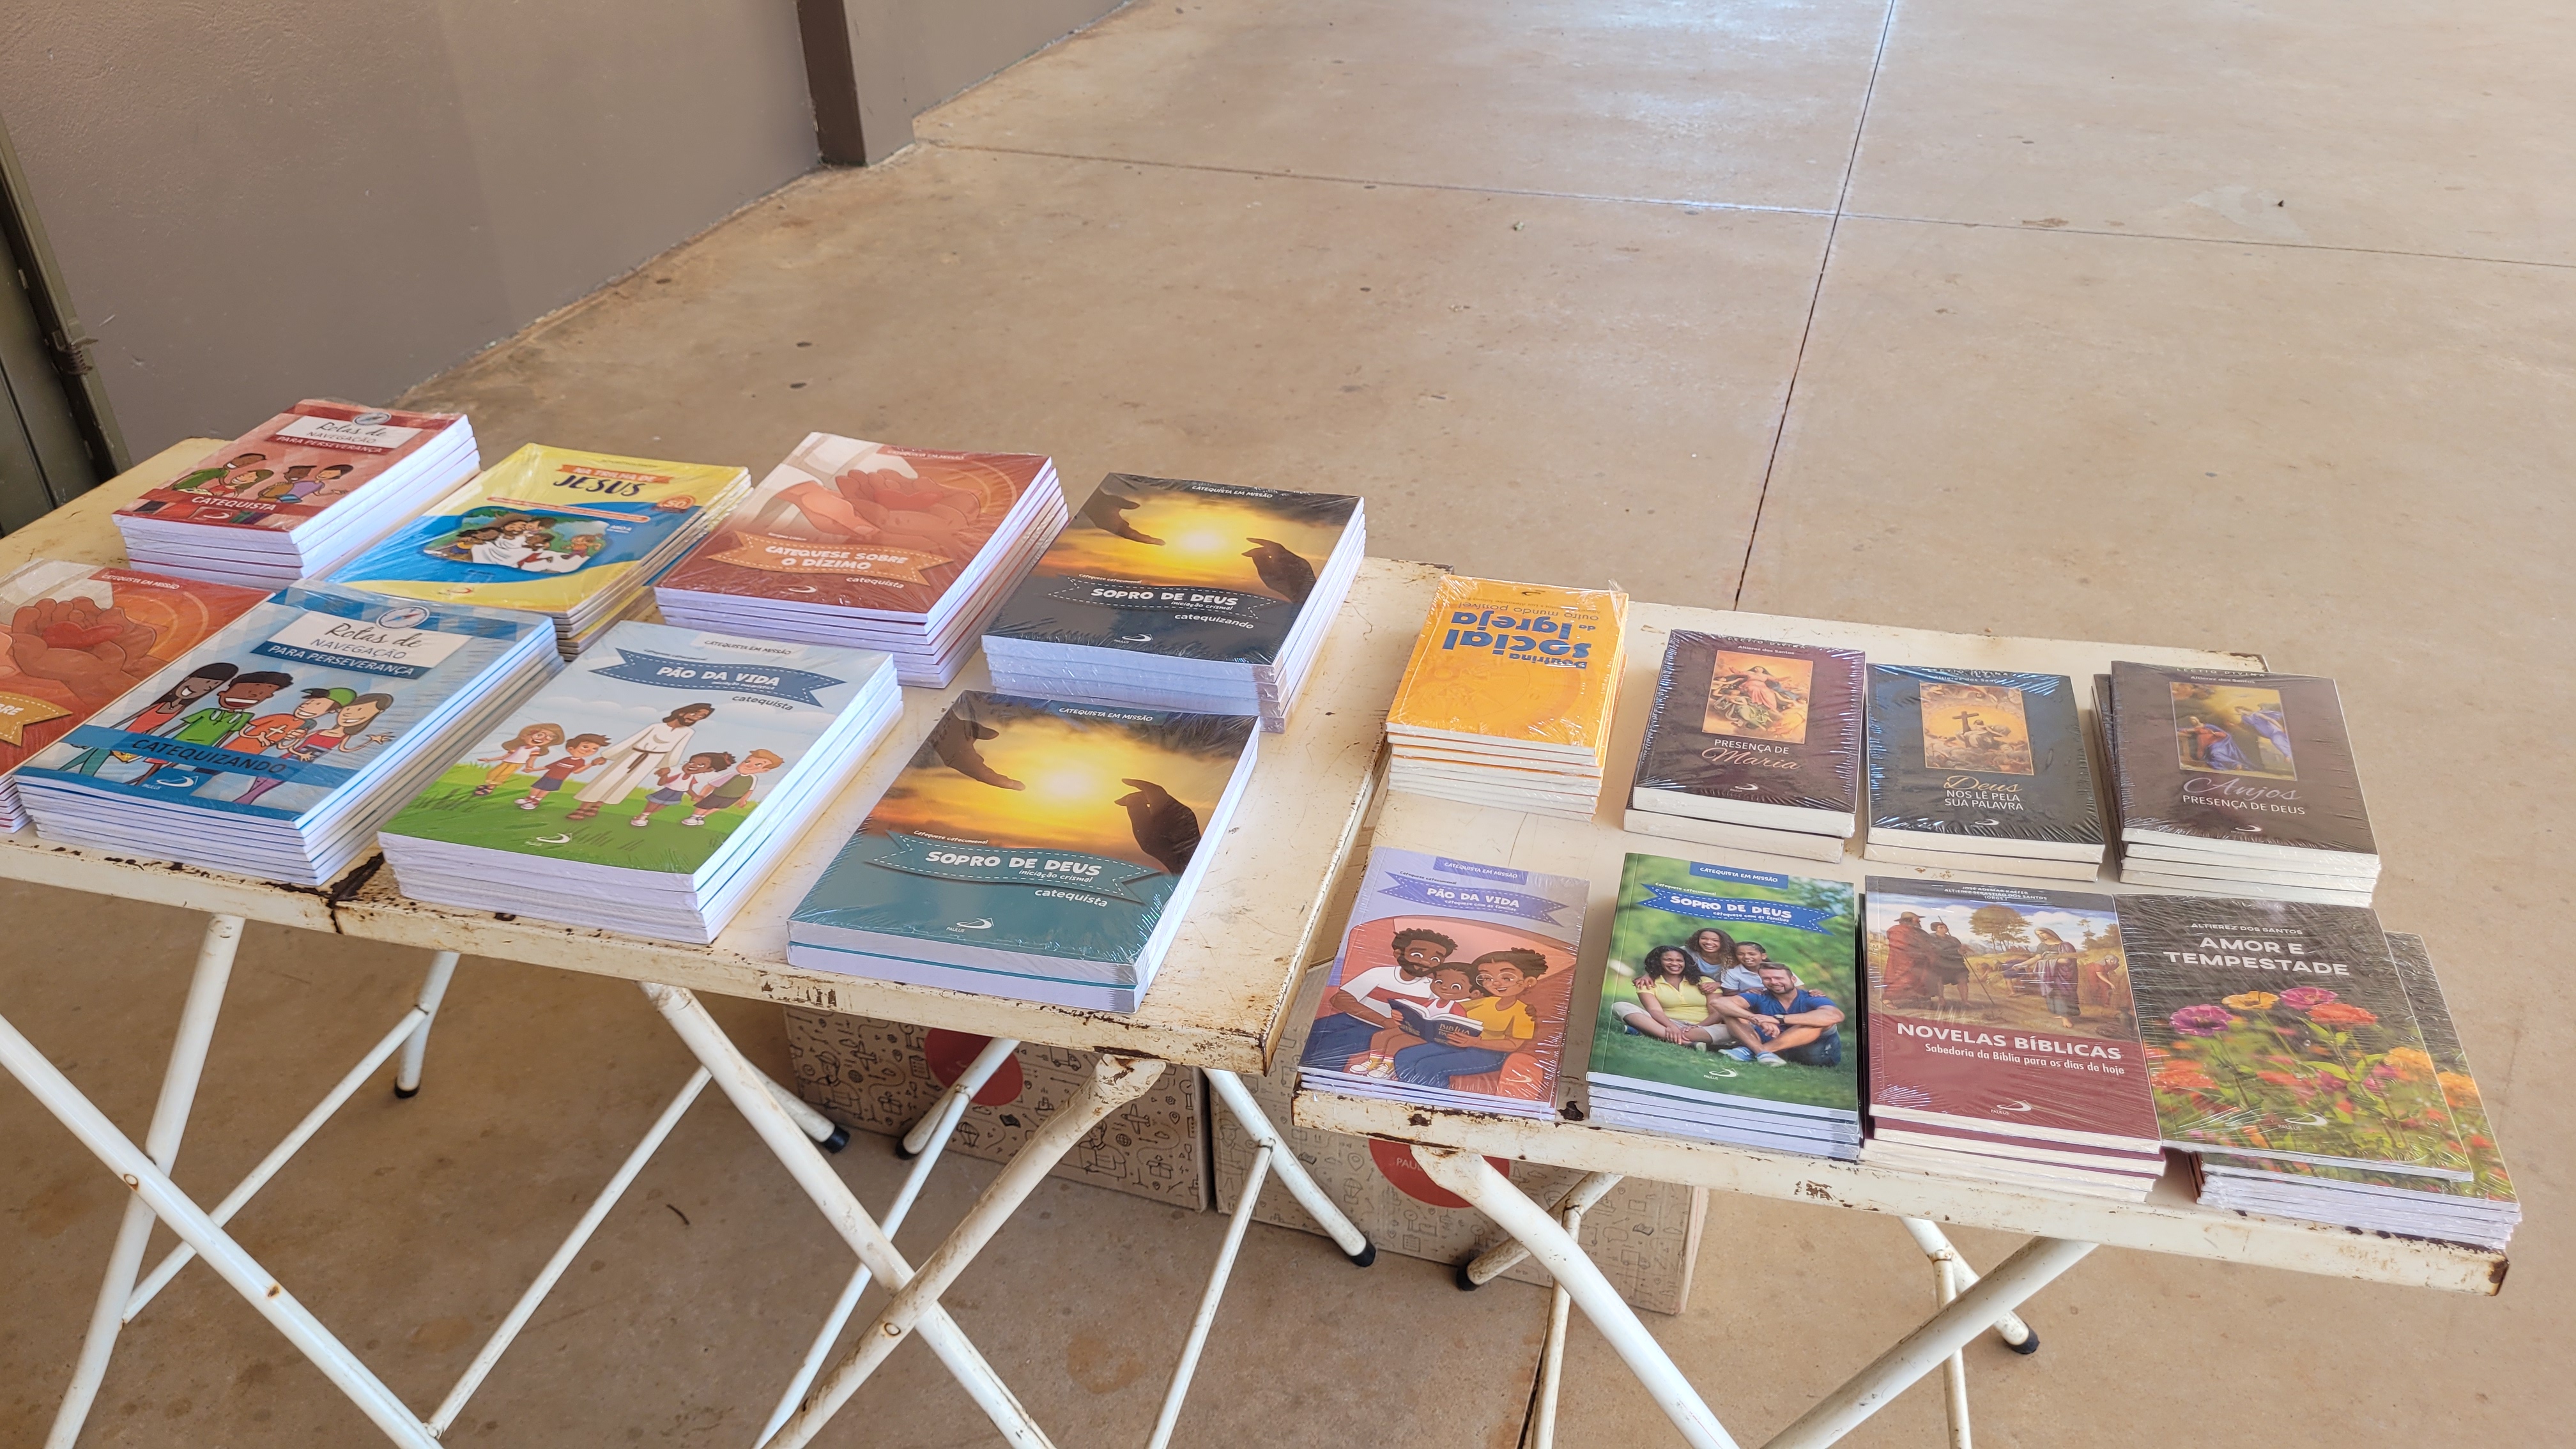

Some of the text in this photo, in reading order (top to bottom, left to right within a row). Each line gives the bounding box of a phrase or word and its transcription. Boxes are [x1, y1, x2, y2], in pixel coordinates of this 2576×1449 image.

[307, 431, 376, 443] NAVEGAÇÃO
[304, 440, 381, 453] PERSEVERANÇA
[553, 475, 645, 496] JESUS
[1192, 486, 1232, 494] CATEQUISTA
[192, 496, 276, 510] CATEQUISTA
[765, 546, 908, 564] CATEQUESE SOBRE
[781, 557, 871, 570] O DÍZIMO
[846, 576, 904, 588] catequista
[1091, 588, 1239, 606] SOPRO DE DEUS
[1459, 601, 1509, 612] possível
[1513, 607, 1559, 617] mundo
[1174, 613, 1254, 629] catequizando
[1563, 611, 1599, 621] outro
[1451, 610, 1572, 640] Igreja
[325, 622, 422, 648] Rotas de
[1442, 628, 1592, 658] social
[311, 639, 407, 659] NAVEGAÇÃO
[705, 640, 748, 650] CATEQUISTA
[763, 647, 792, 655] MISSÃO
[268, 645, 414, 675] PARA PERSEVERANÇA
[1508, 652, 1588, 670] Doutrina
[656, 666, 781, 686] PÃO DA VIDA
[732, 695, 793, 711] catequista
[1059, 707, 1105, 717] CATEQUISTA
[1715, 739, 1789, 755] PRESENÇA DE
[132, 739, 287, 773] CATEQUIZANDO
[1701, 747, 1801, 770] Maria
[1943, 775, 2022, 792] Deus
[2183, 778, 2301, 801] Anjos
[1947, 790, 2020, 802] NOS LÊ PELA
[1945, 799, 2024, 811] SUA PALAVRA
[2182, 795, 2305, 815] PRESENÇA DE DEUS
[913, 830, 989, 845] Catequese catecumenal
[925, 851, 1102, 877] SOPRO DE DEUS
[1444, 862, 1481, 873] CATEQUISTA
[1494, 870, 1518, 878] MISSÃO
[1699, 867, 1738, 877] CATEQUISTA
[1018, 869, 1094, 883] iniciação crismal
[1034, 889, 1108, 908] catequista
[1427, 887, 1520, 908] PÃO DA VIDA
[1670, 896, 1792, 919] SOPRO DE DEUS
[2200, 937, 2304, 955] AMOR E
[2163, 951, 2350, 976] TEMPESTADE
[1897, 1022, 2122, 1060] NOVELAS BÍBLICAS
[1925, 1043, 1974, 1057] Sabedoria
[1977, 1049, 1989, 1059] da
[1993, 1051, 2020, 1063] Bíblia
[2023, 1057, 2047, 1066] para
[2064, 1059, 2084, 1070] dias
[2087, 1062, 2100, 1071] de
[2102, 1063, 2125, 1076] hoje
[1396, 1157, 1423, 1171] PAUL
